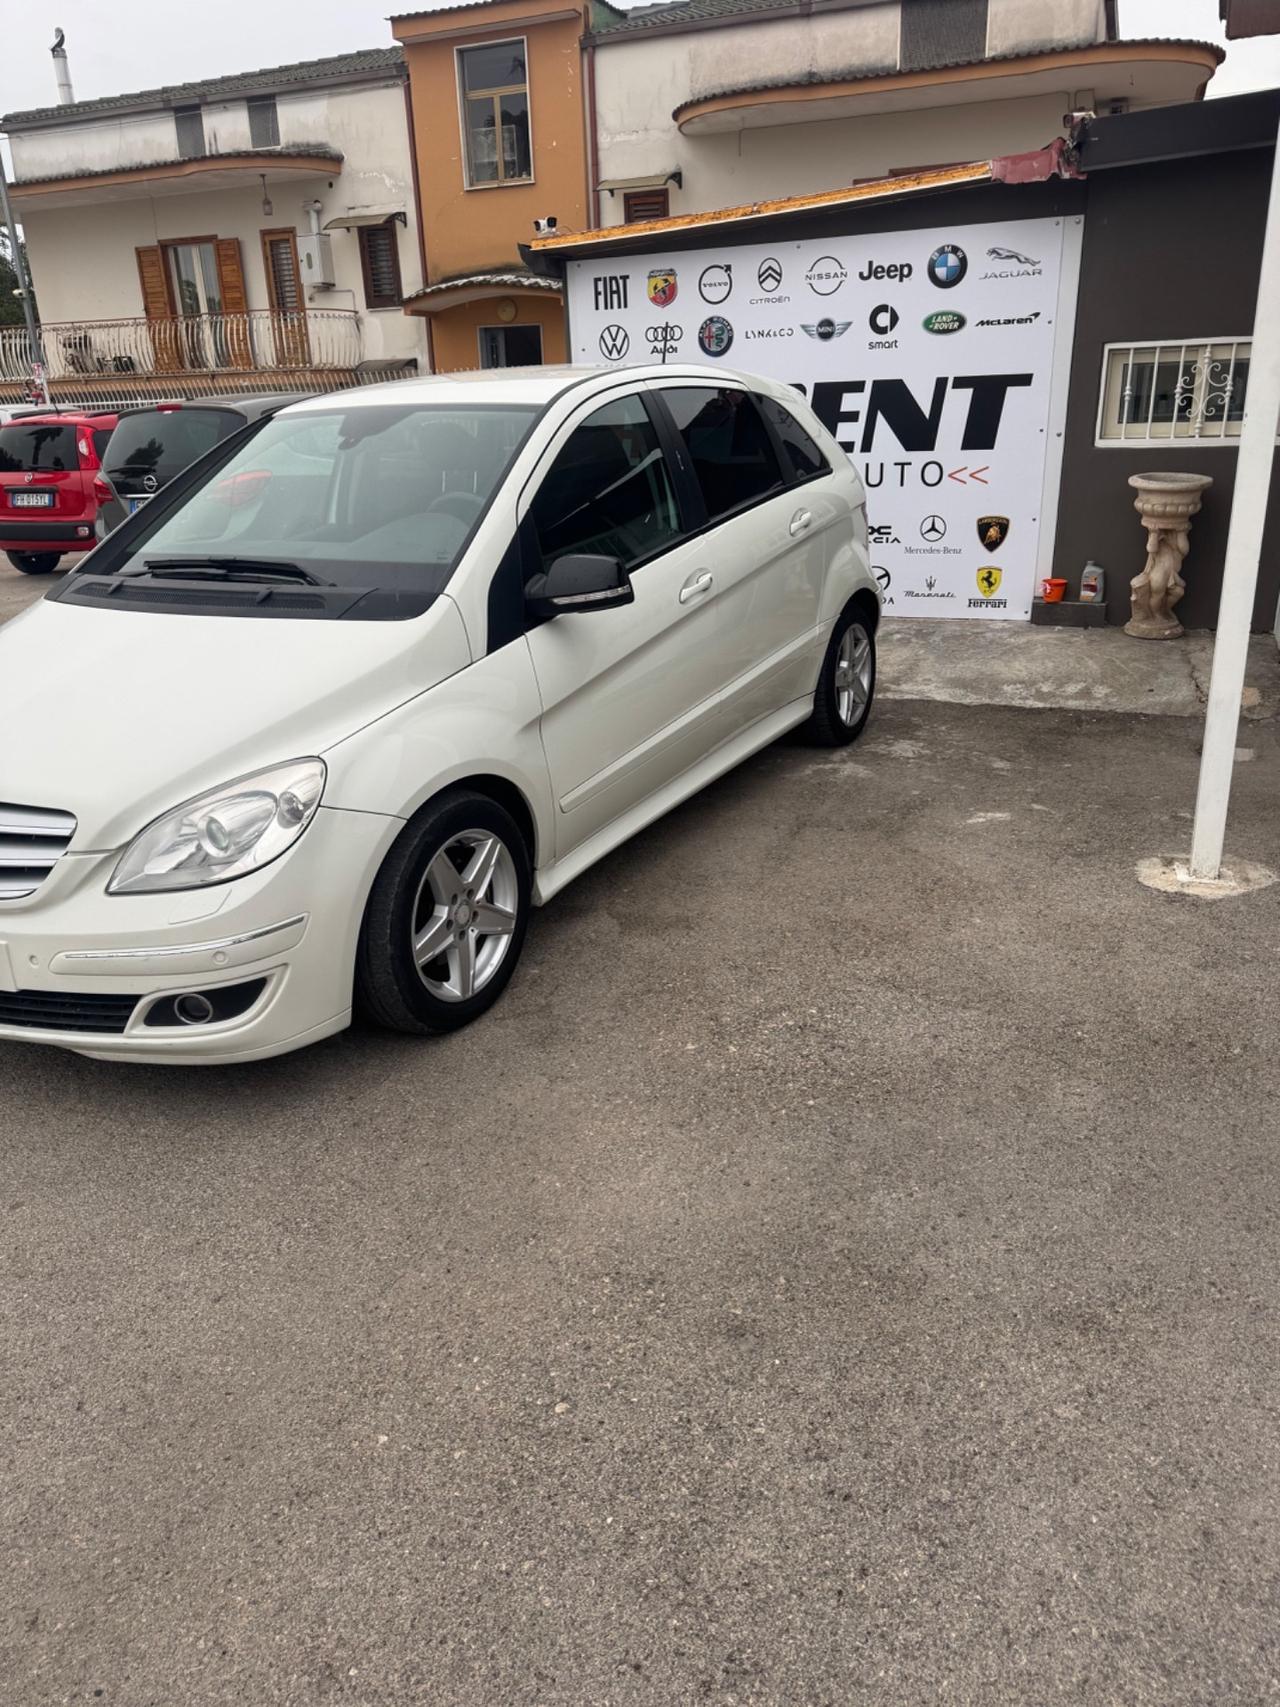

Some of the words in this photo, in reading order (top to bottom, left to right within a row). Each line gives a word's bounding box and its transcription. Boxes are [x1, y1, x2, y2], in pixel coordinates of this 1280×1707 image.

[805, 271, 848, 281] NISSAN
[858, 260, 913, 282] Jeep
[979, 268, 1043, 280] JAGUAR
[593, 274, 630, 311] FIAT
[932, 314, 954, 323] LAND
[975, 317, 1033, 327] McLaren
[933, 321, 960, 331] ROVER
[868, 339, 898, 350] smart
[788, 373, 1034, 453] ENT
[865, 461, 944, 488] UTO
[904, 546, 962, 555] Mercedes-Benz
[967, 598, 1007, 608] Ferrari
